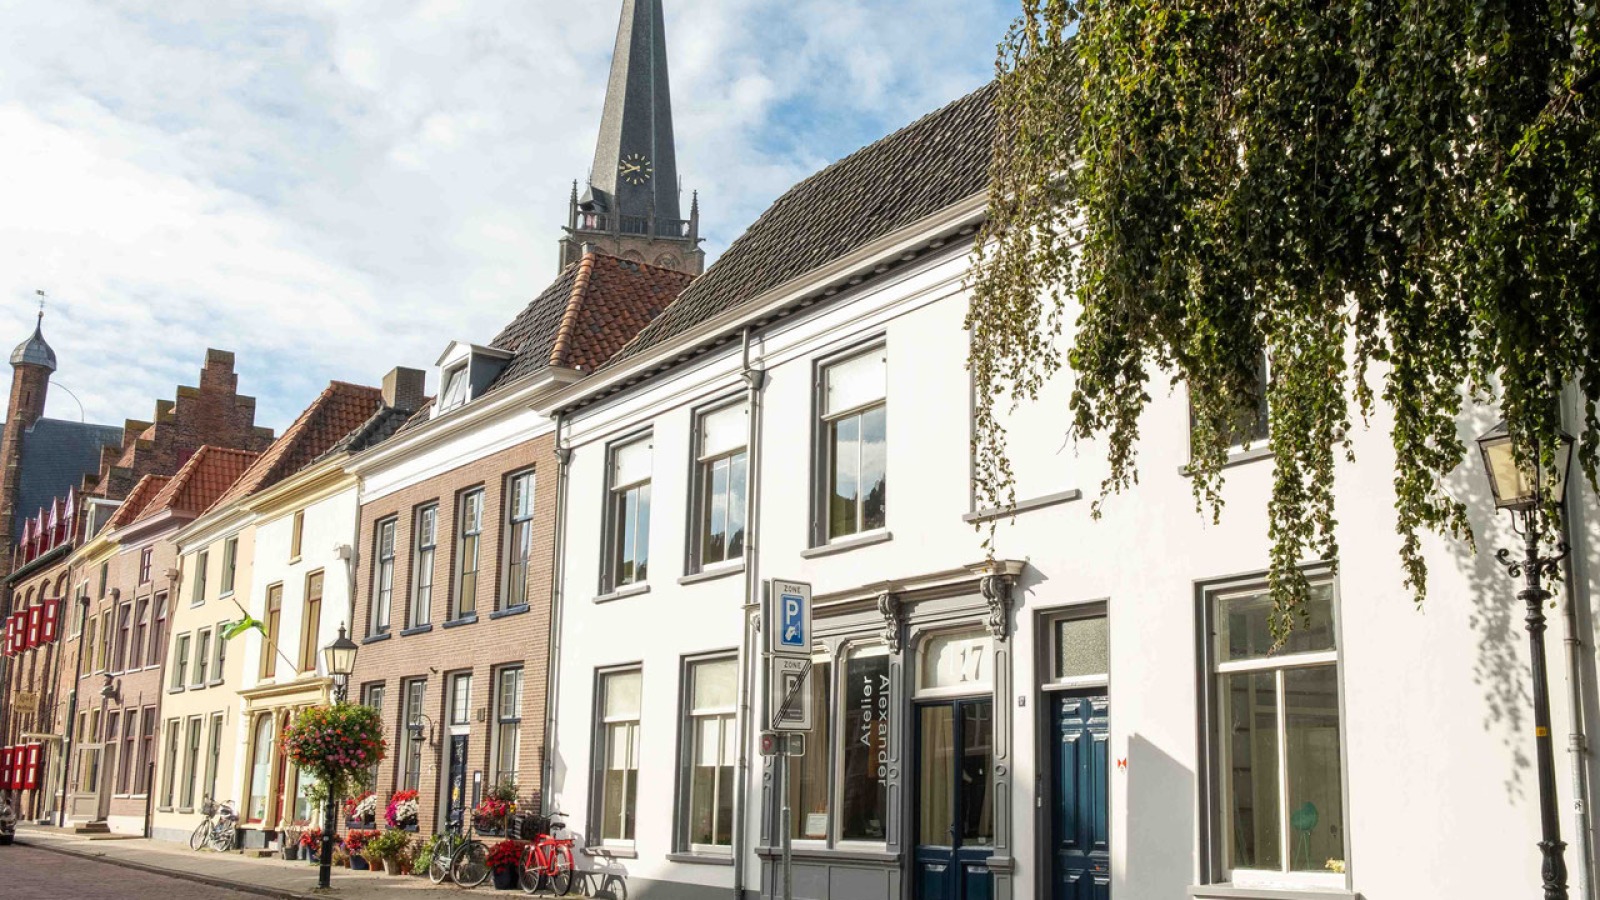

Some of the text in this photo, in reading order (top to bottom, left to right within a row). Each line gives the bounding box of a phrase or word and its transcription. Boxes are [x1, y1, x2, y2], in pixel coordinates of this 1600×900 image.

[784, 584, 801, 593] ZONE
[786, 599, 799, 625] P
[784, 660, 802, 669] ZONE
[959, 645, 984, 682] 17
[860, 675, 872, 747] Atelier
[878, 674, 890, 787] Alexander
